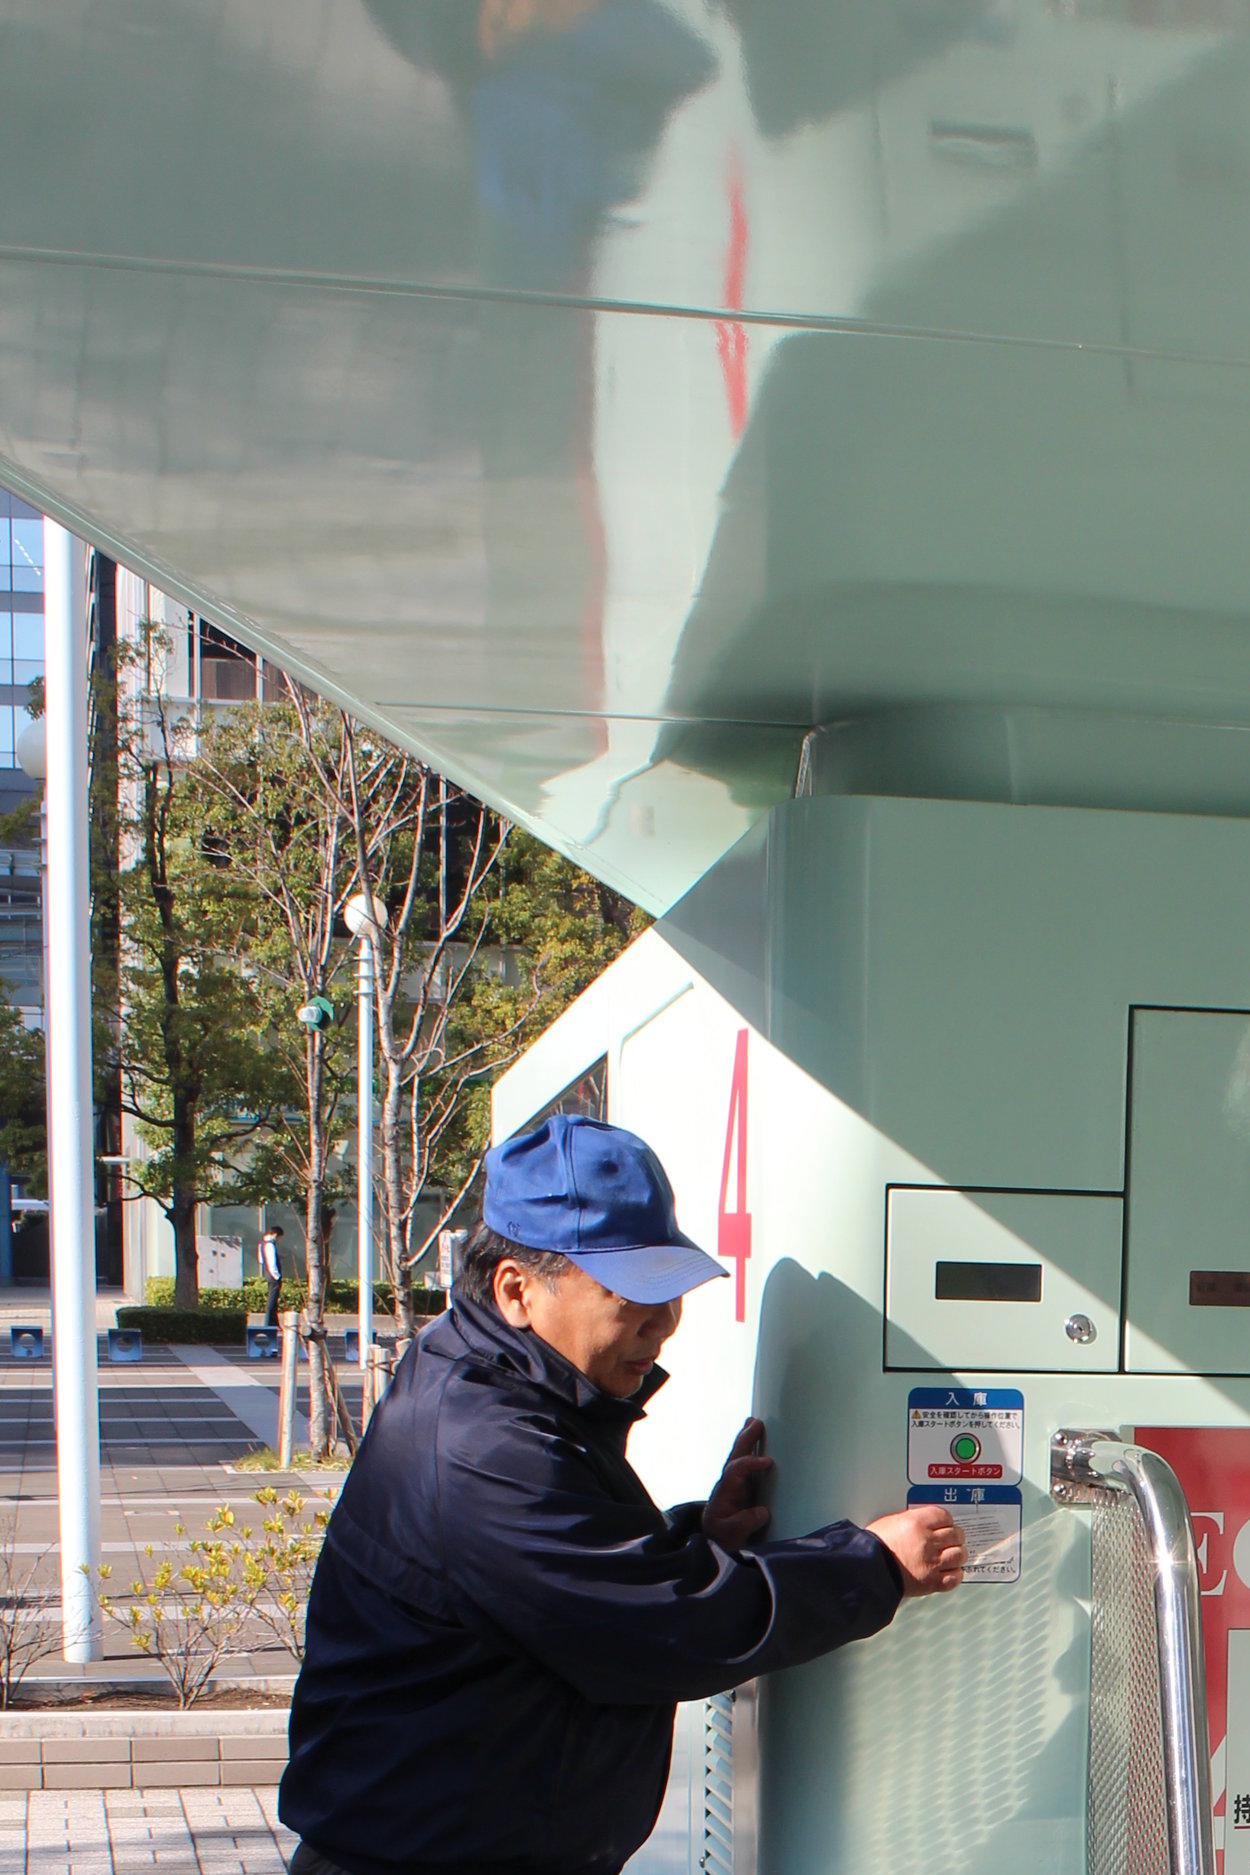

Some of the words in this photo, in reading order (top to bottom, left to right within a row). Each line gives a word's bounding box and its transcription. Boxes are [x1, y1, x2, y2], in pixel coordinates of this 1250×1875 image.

[930, 1466, 1001, 1477] 入庫スタートボタン
